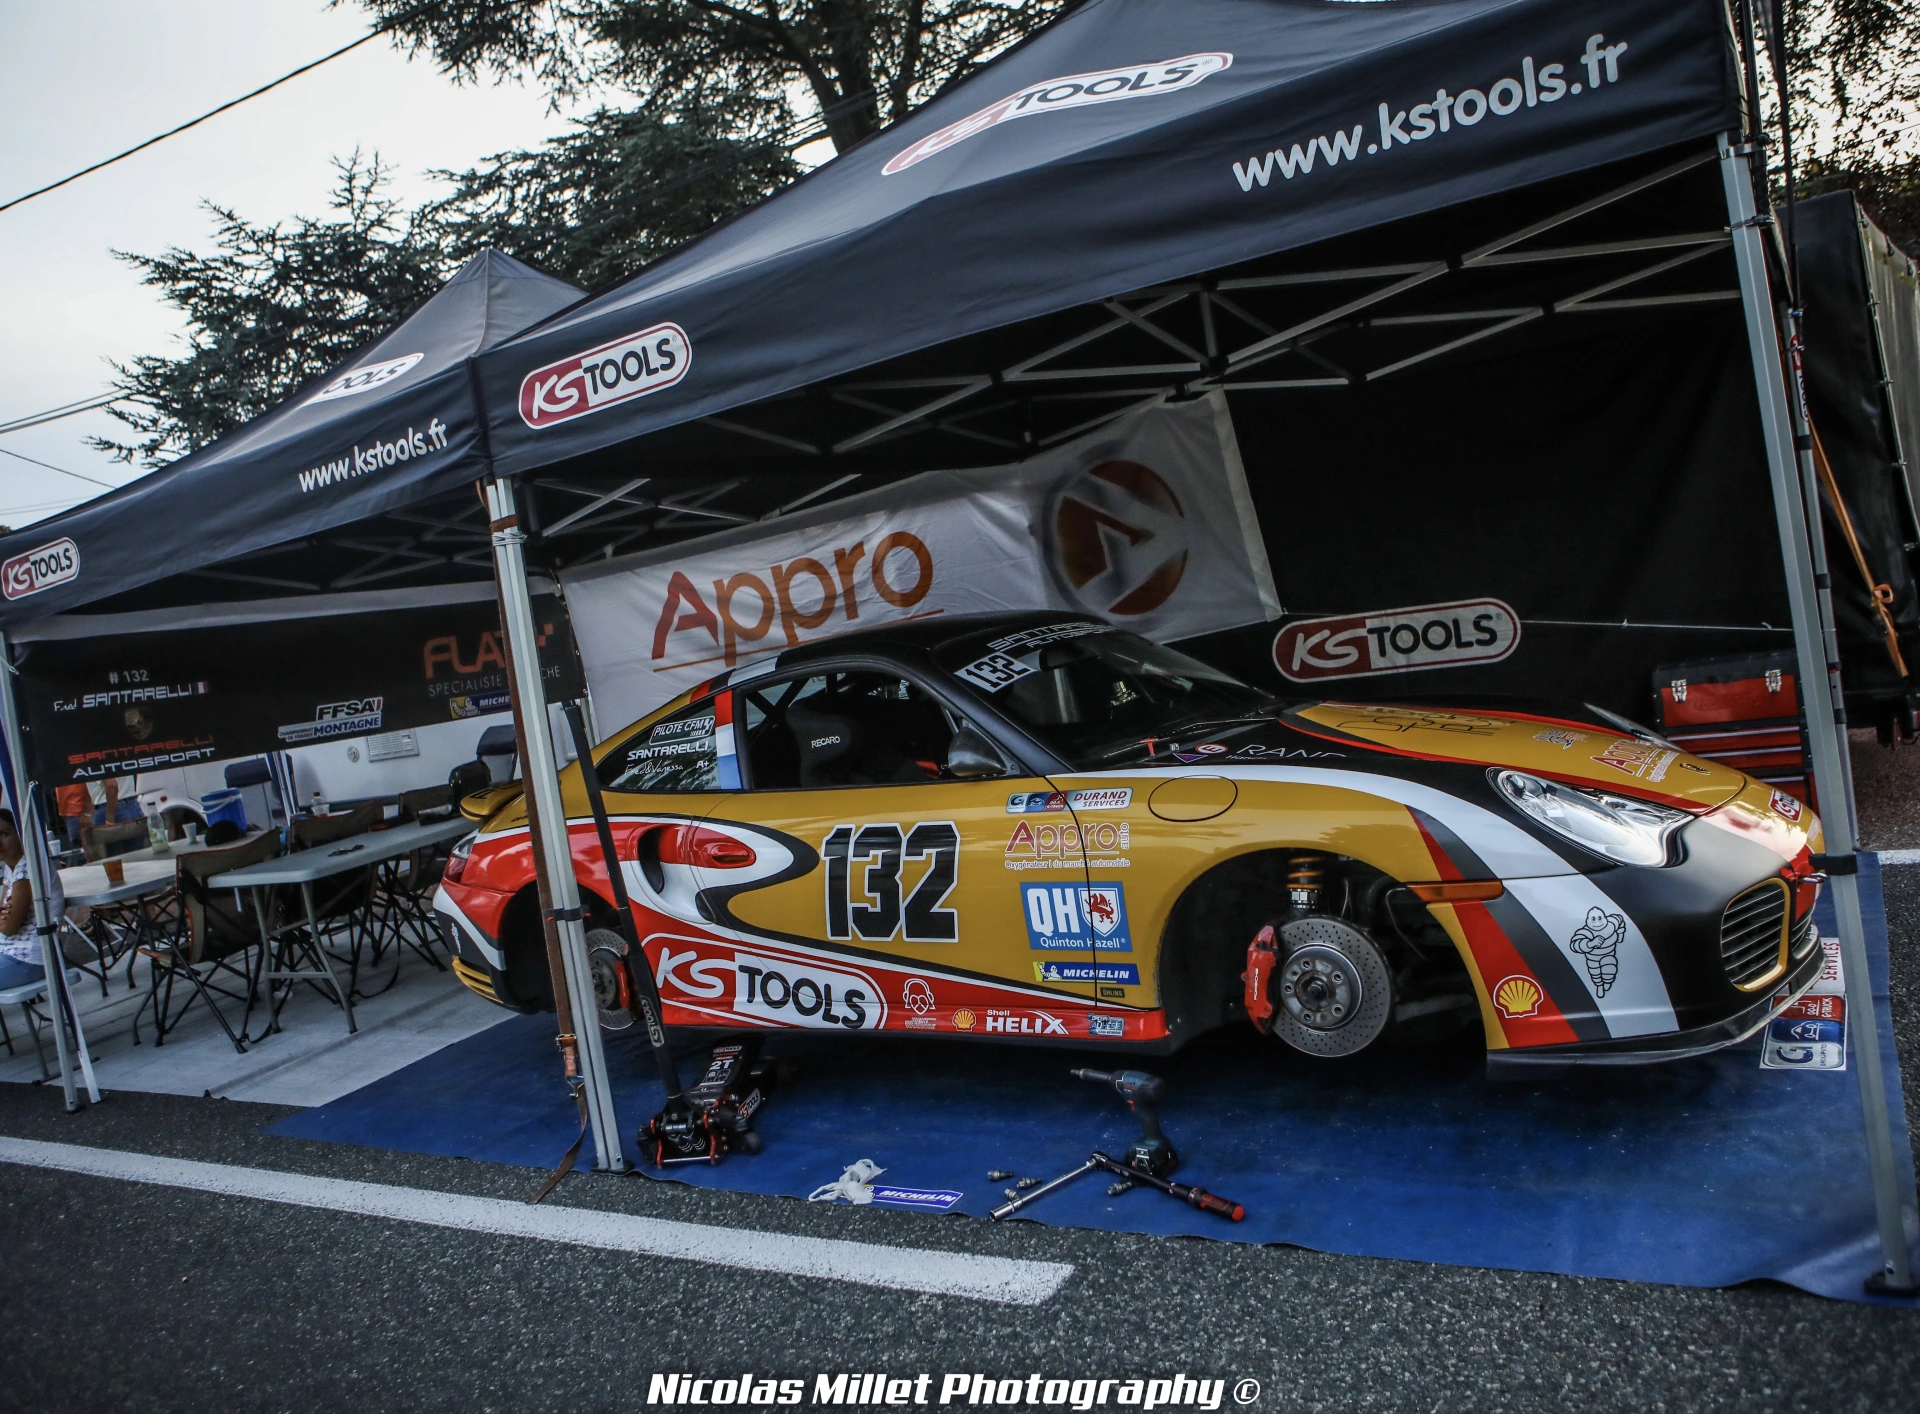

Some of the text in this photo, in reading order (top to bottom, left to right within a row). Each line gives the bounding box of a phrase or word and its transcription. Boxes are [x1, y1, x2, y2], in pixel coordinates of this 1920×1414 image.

[1232, 34, 1628, 192] www.kstools.fr
[299, 417, 448, 493] www.kstools.fr
[652, 531, 933, 667] Appro
[123, 669, 150, 683] 132
[965, 654, 1031, 689] 132
[83, 683, 192, 708] SANTARELLI
[428, 674, 502, 697] SPECIALISTE
[318, 699, 376, 721] FFSA
[479, 695, 512, 708] MICHE
[313, 716, 380, 737] MONTAGNE
[652, 722, 684, 737] PILOTE
[68, 735, 214, 765] SANTARELLI
[626, 740, 709, 761] SANTARELLI
[811, 735, 841, 749] RECARO
[72, 748, 215, 779] AUTOSPORT
[1073, 790, 1128, 802] DURAND
[1082, 799, 1127, 808] SERVICES
[1005, 820, 1120, 859] Appro
[1119, 822, 1130, 850] auto
[821, 821, 960, 942] 132
[1026, 887, 1081, 936] QH
[1040, 937, 1120, 949] Quinton Hazell
[1063, 968, 1130, 979] MICHELIN
[985, 1013, 1070, 1035] HELIX
[709, 1059, 735, 1071] 2T
[879, 1190, 958, 1202] MICHELIN
